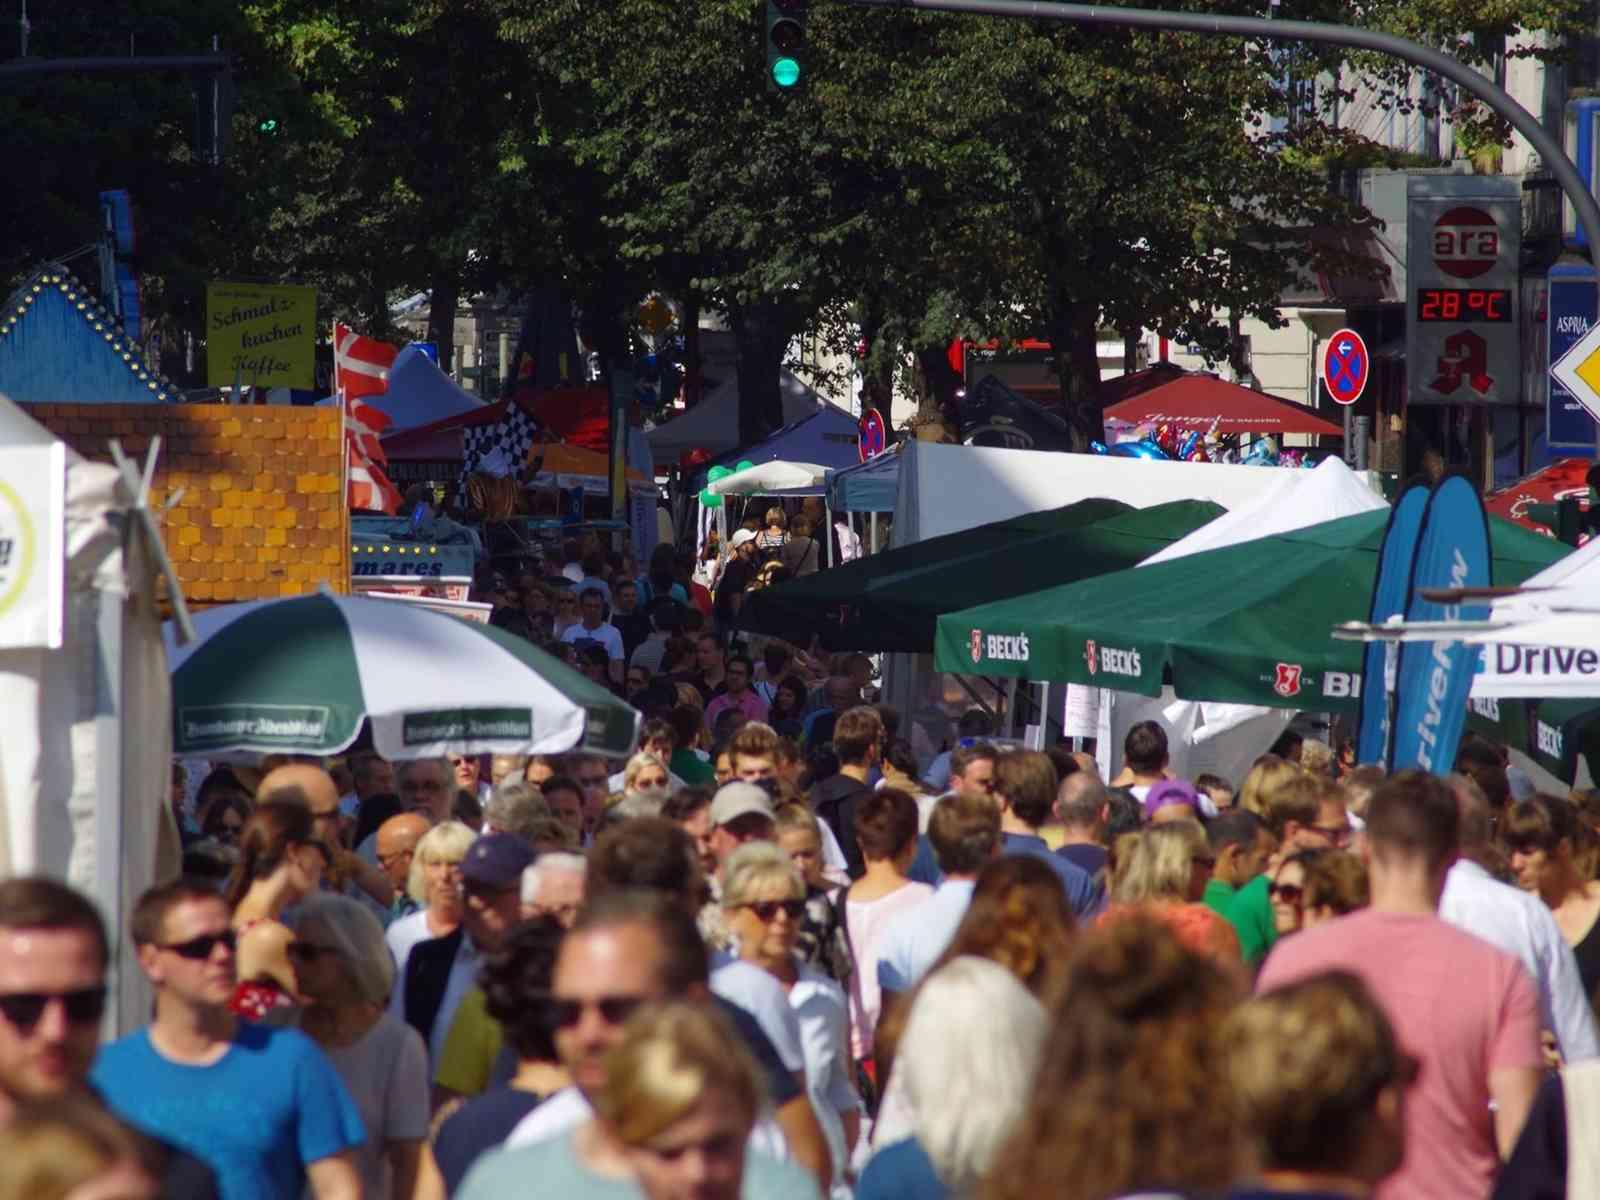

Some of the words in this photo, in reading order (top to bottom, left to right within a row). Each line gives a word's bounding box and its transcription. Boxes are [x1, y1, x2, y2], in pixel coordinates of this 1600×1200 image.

[1434, 231, 1498, 255] ara
[1422, 292, 1461, 320] 28
[987, 632, 1030, 662] BECK'S
[1101, 647, 1142, 677] BECK'S
